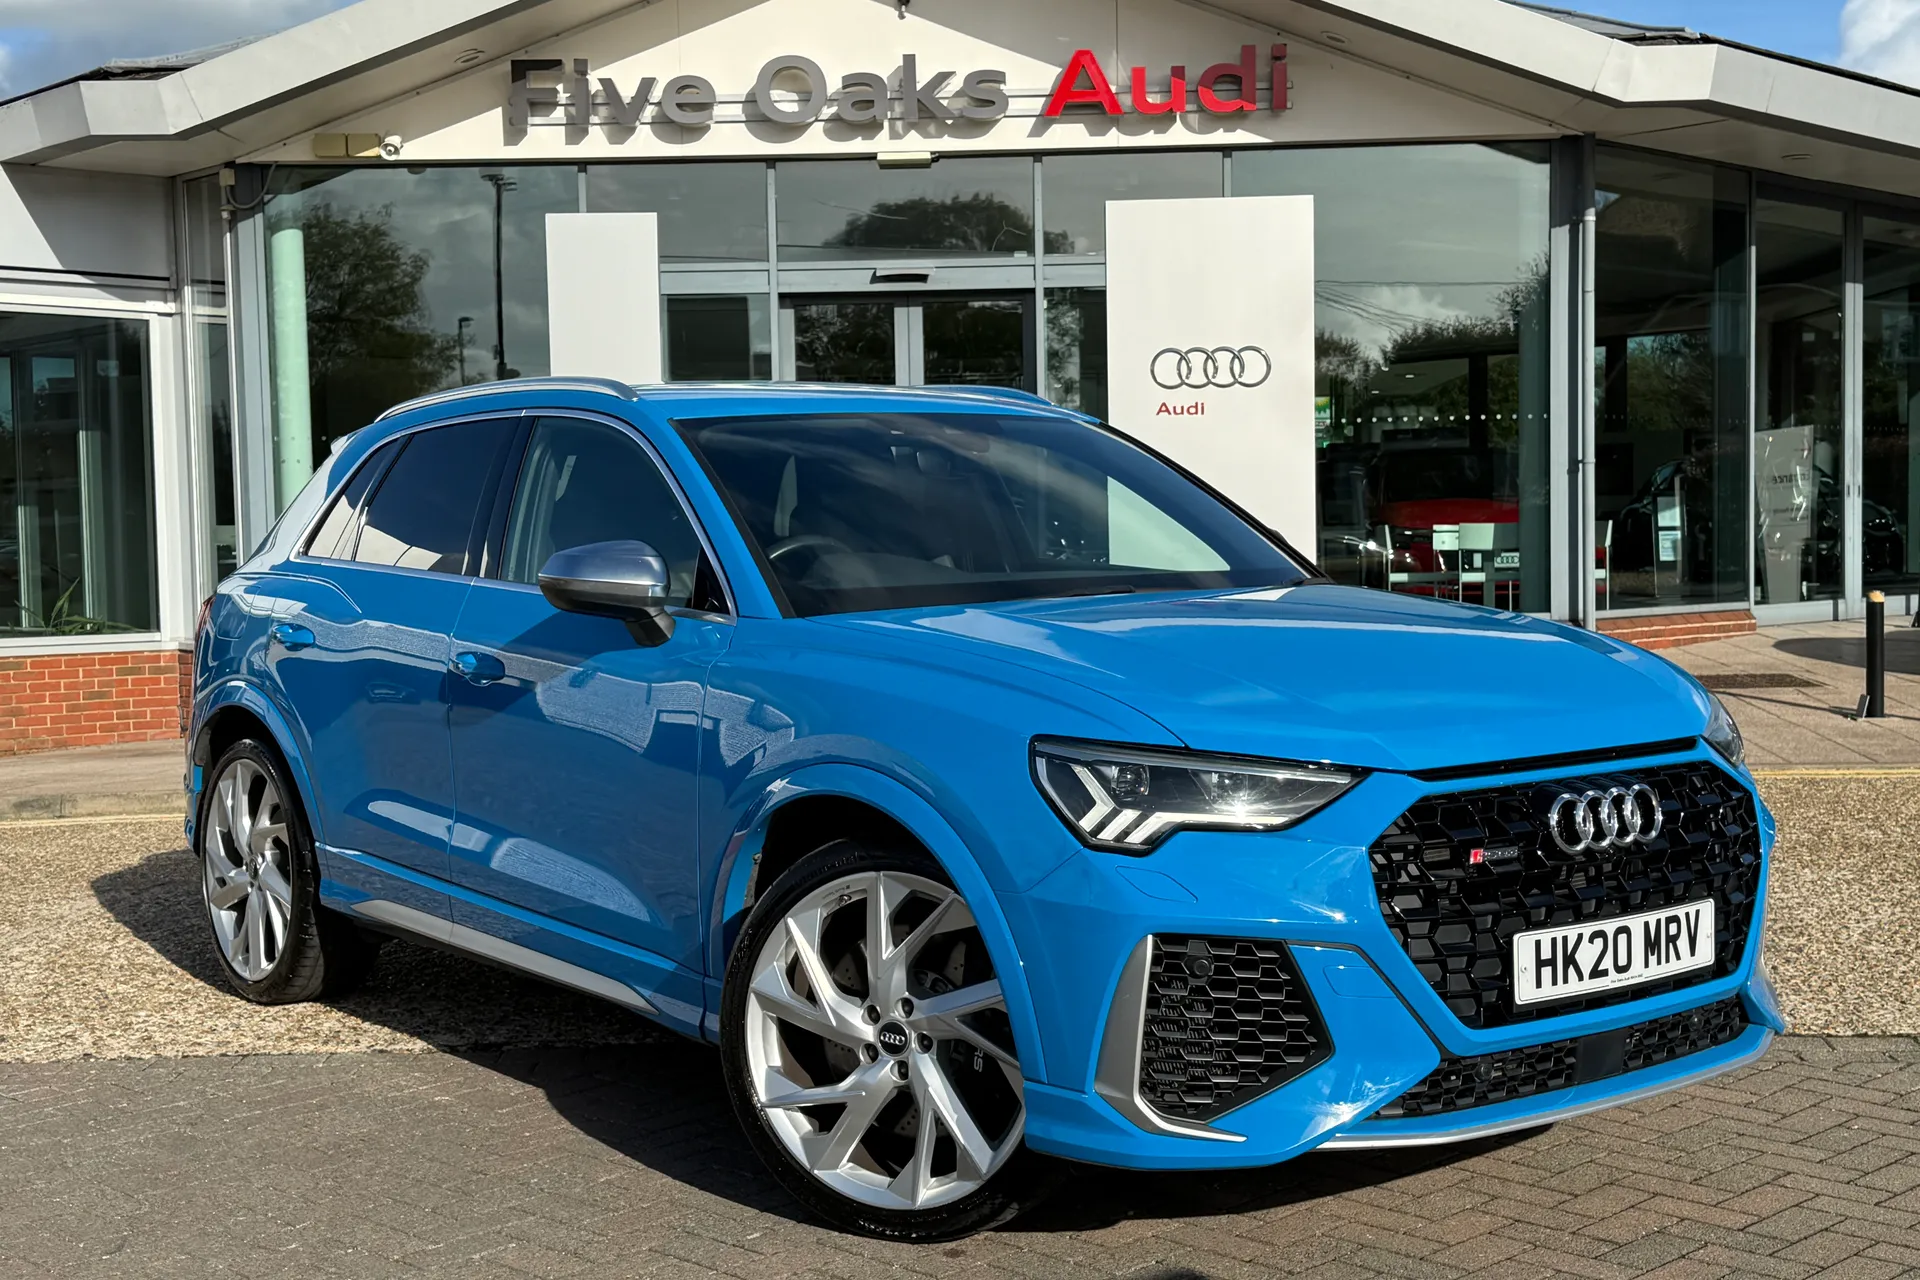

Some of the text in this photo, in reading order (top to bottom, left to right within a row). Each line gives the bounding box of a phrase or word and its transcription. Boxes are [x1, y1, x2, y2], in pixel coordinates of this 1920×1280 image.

[511, 43, 1288, 125] Five Oaks Audi
[1156, 402, 1205, 415] Audi
[1535, 909, 1700, 989] HK20 MRV
